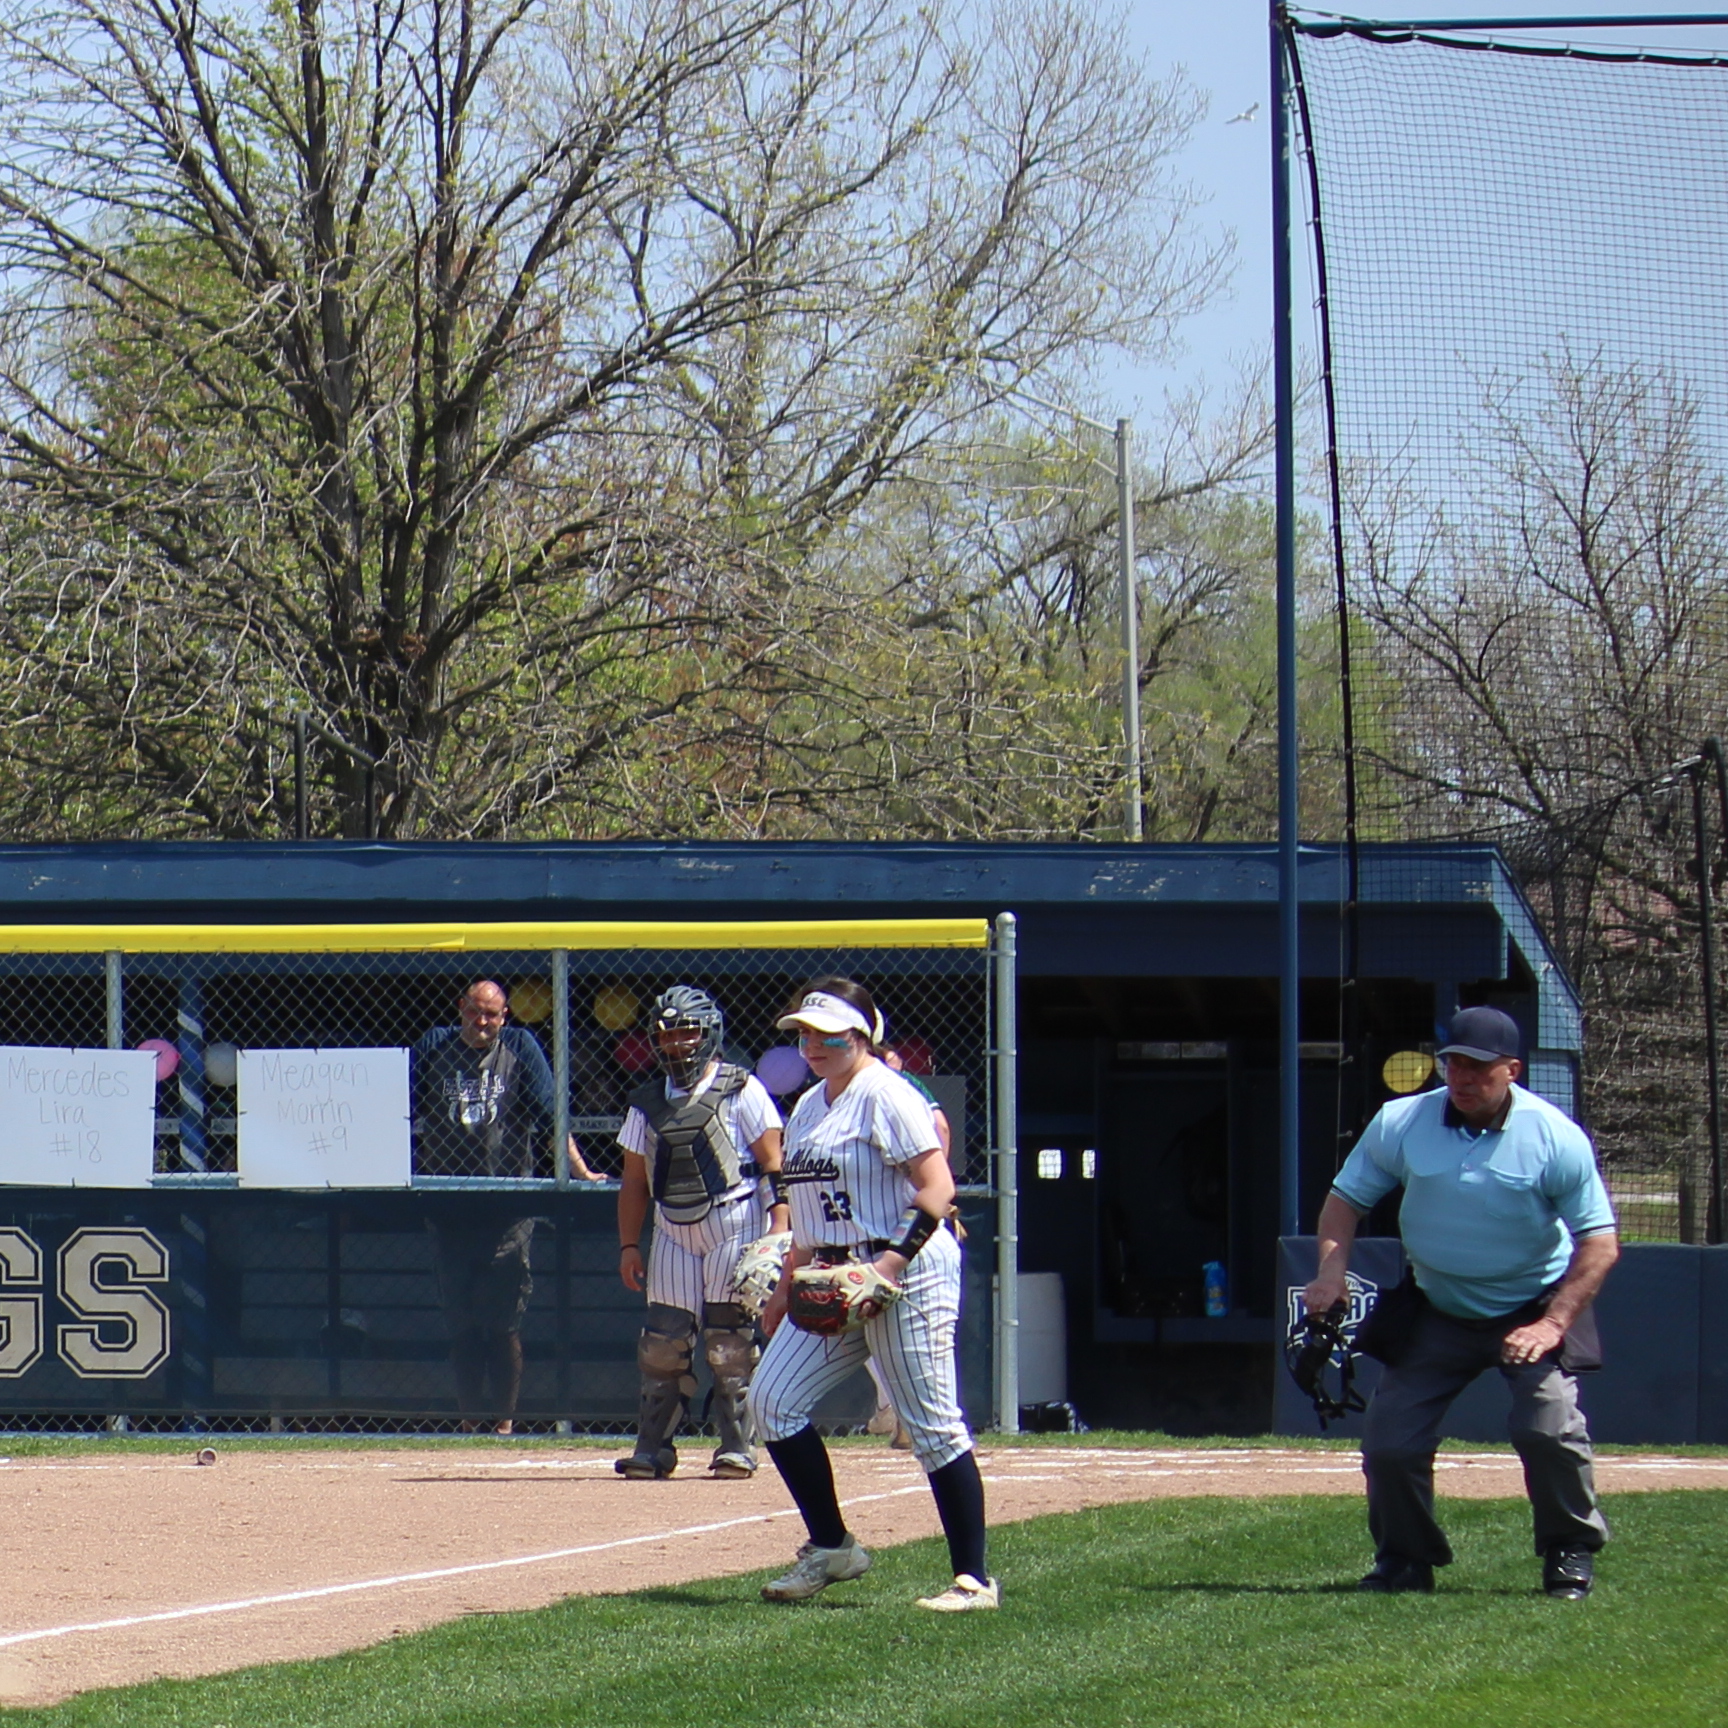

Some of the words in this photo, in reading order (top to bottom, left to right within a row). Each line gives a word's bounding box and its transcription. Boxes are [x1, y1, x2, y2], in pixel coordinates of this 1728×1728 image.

[8, 1055, 130, 1098] Mercedes
[261, 1053, 369, 1100] Meagan
[39, 1097, 91, 1128] Lira
[48, 1130, 102, 1164] #18
[307, 1125, 348, 1155] #9
[820, 1191, 853, 1222] 23
